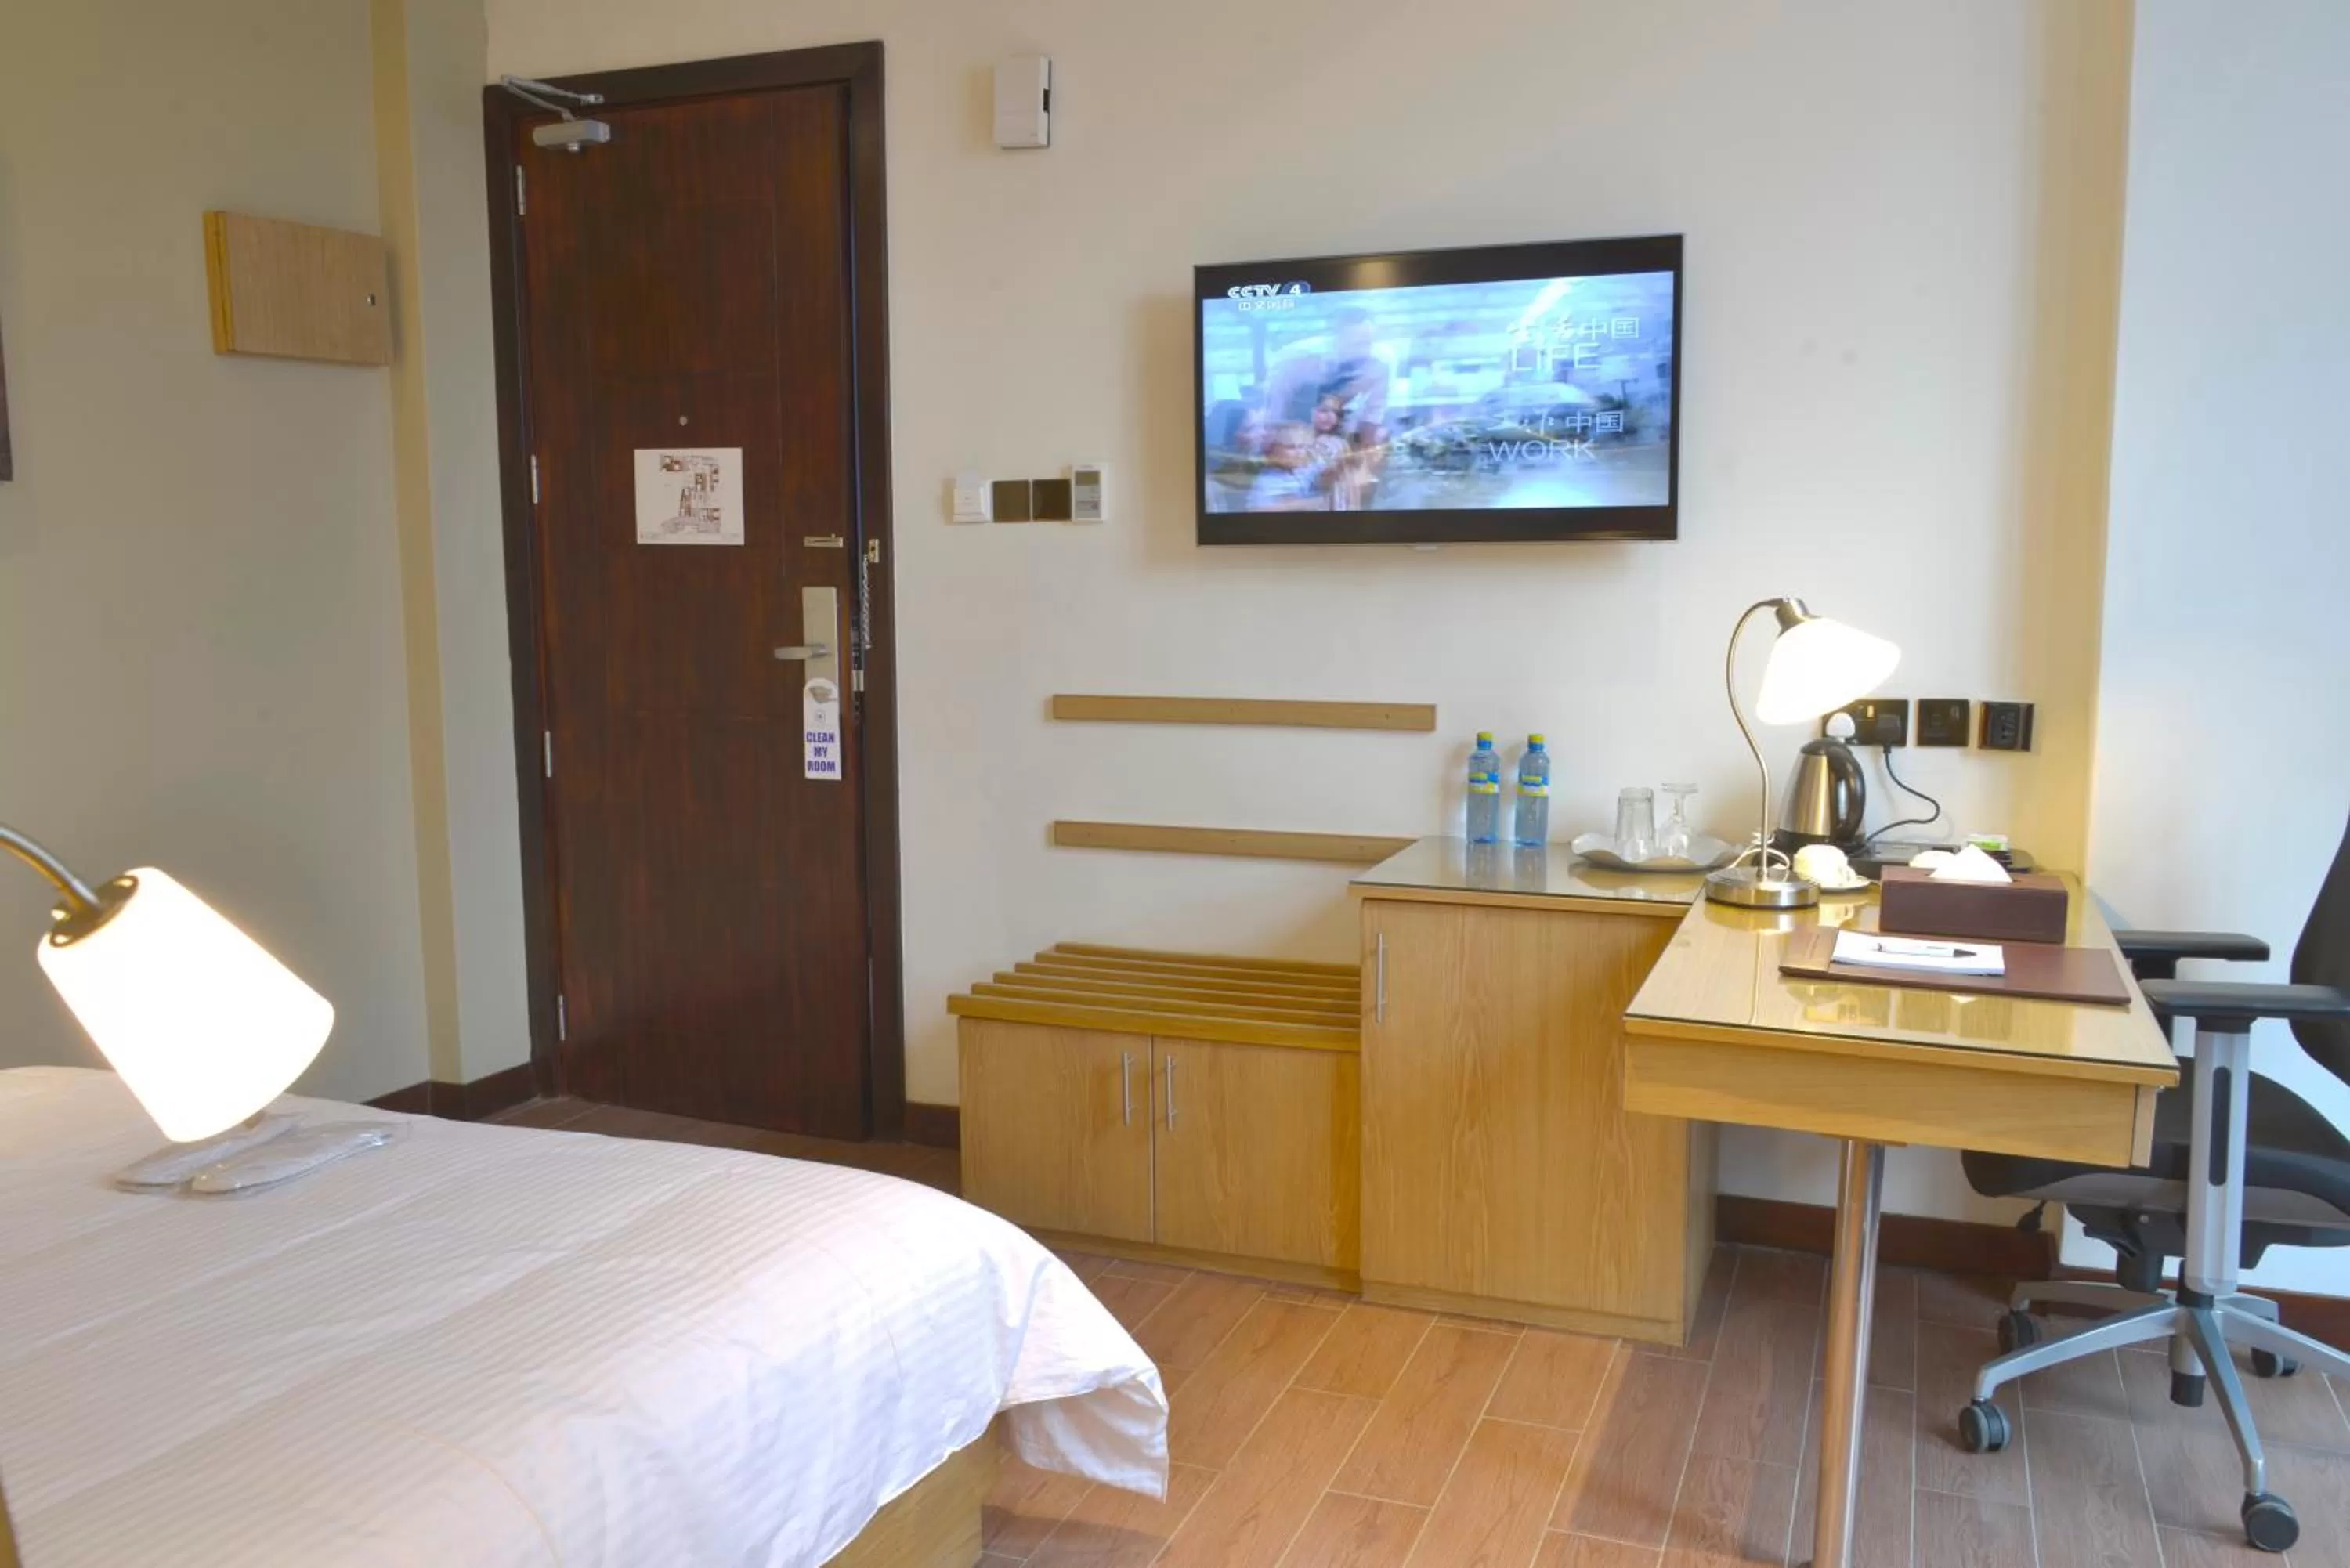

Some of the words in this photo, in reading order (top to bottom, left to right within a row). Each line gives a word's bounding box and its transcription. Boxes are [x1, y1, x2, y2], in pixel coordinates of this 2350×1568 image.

[1227, 283, 1282, 298] CCTV
[1289, 284, 1301, 296] 4
[1511, 341, 1601, 372] LIFE
[1488, 438, 1596, 461] WORK
[806, 732, 835, 743] CLEAN
[814, 746, 828, 757] MY
[808, 761, 836, 772] ROOM
